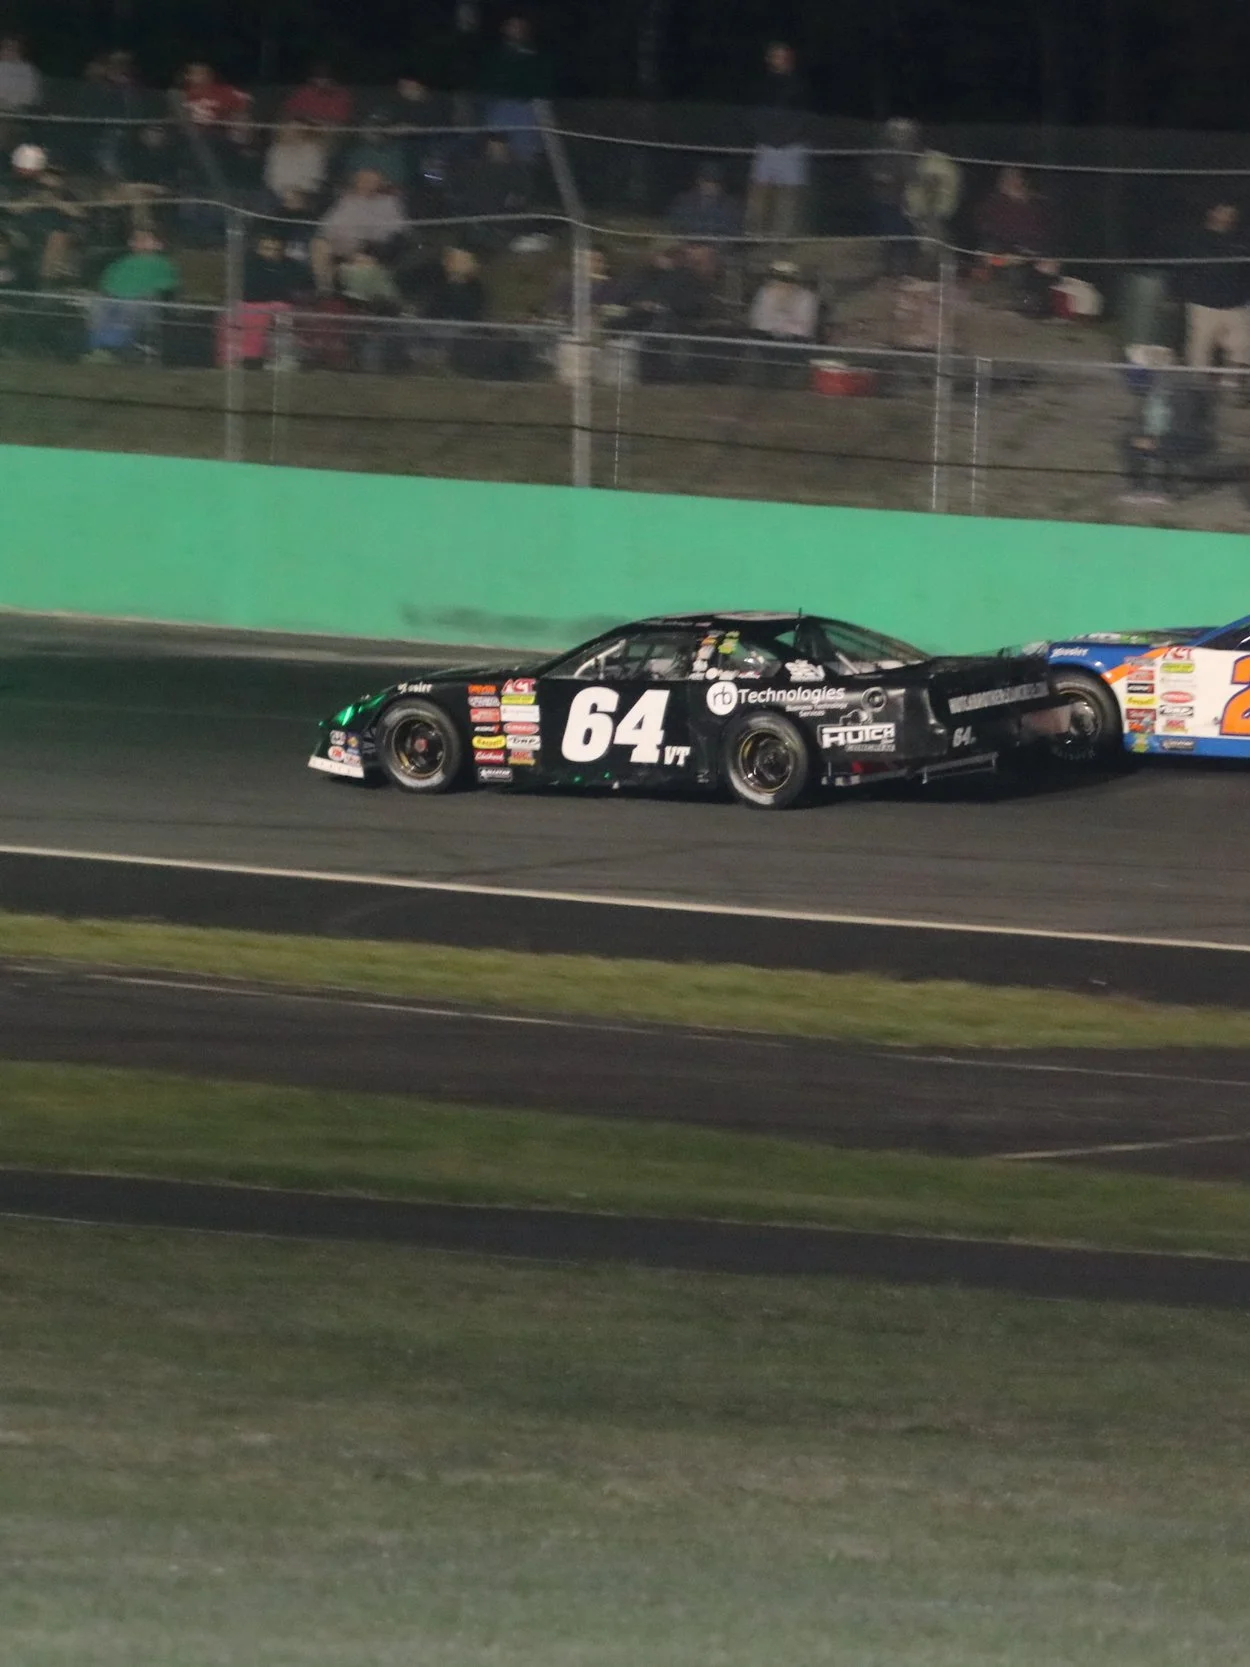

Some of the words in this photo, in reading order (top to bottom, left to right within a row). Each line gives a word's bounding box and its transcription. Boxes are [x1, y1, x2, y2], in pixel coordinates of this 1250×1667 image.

[502, 679, 536, 693] ACT
[737, 686, 846, 705] Technologies
[561, 686, 670, 763] 64
[664, 745, 691, 766] VT
